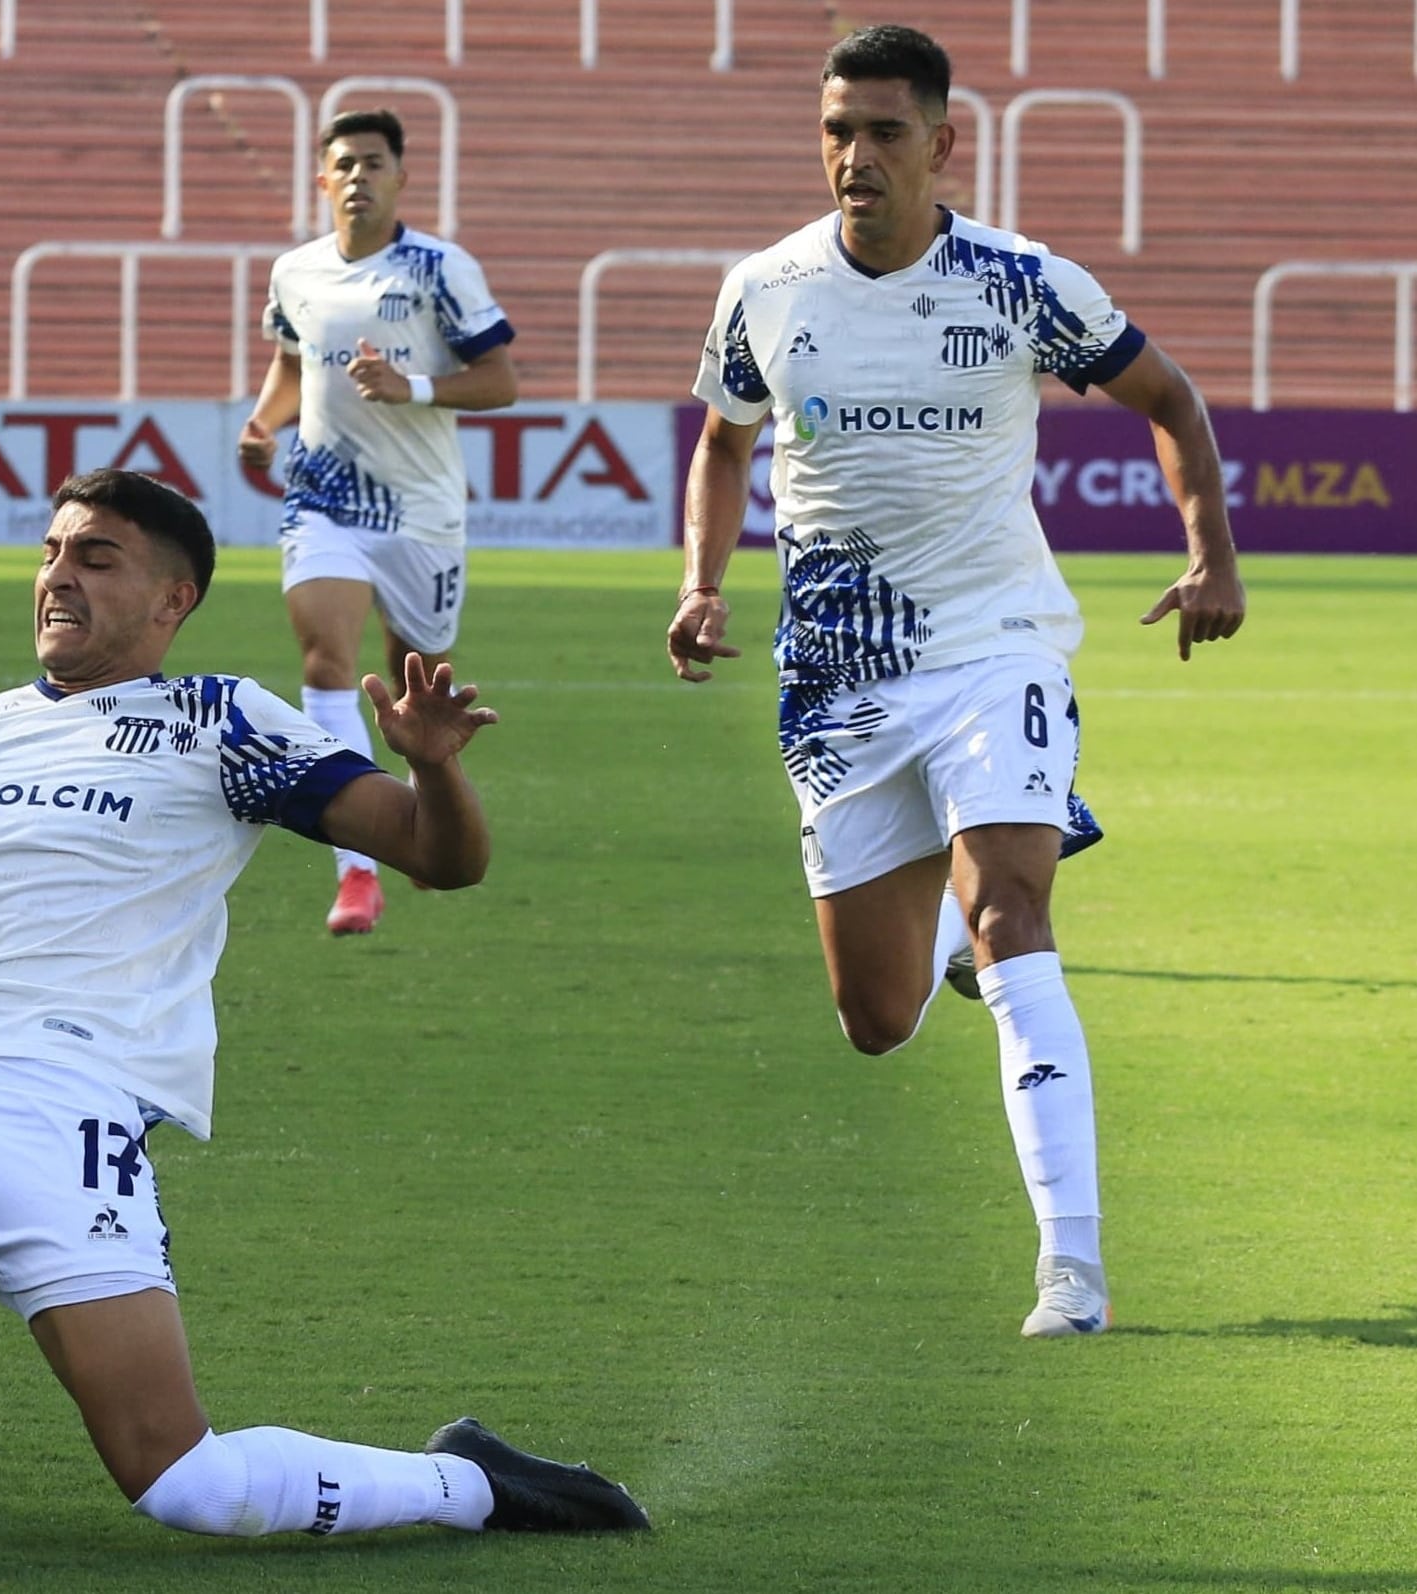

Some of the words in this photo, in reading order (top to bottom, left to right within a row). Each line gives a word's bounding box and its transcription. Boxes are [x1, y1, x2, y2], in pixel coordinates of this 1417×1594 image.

[760, 266, 826, 291] ADVANTA
[951, 261, 1016, 291] ADVANTA
[321, 346, 412, 368] HOIM
[839, 405, 984, 432] HOLCIM
[1254, 463, 1391, 509] MZA
[432, 565, 460, 615] 15
[1023, 682, 1049, 749] 6
[78, 1118, 142, 1197] 17
